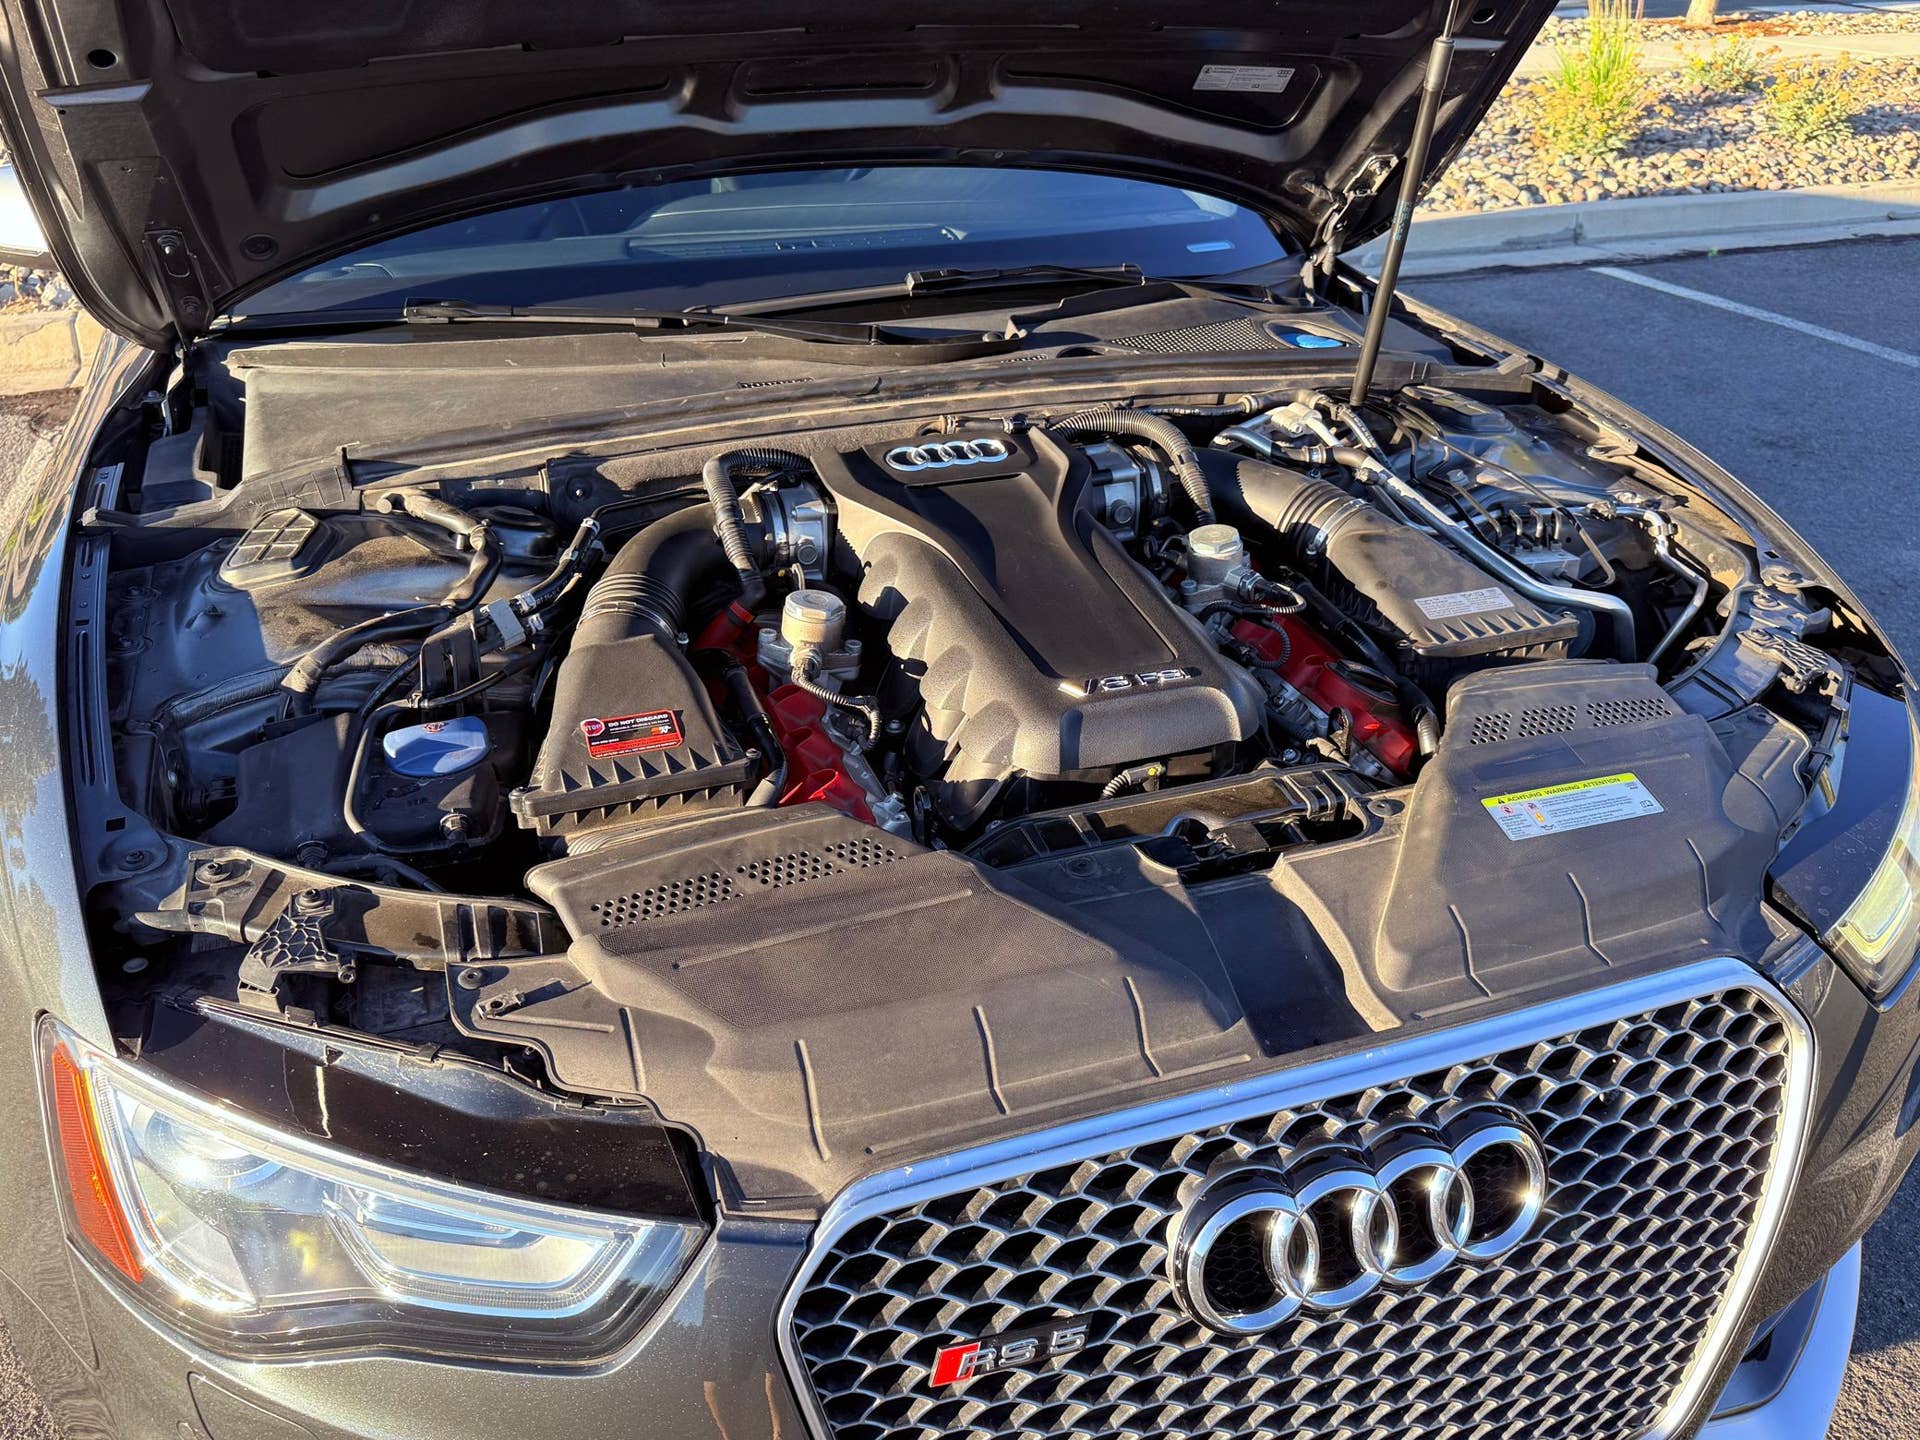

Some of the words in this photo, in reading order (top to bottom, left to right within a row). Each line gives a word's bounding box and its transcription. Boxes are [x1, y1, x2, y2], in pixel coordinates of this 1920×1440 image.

[636, 714, 668, 723] DISCARD
[1507, 791, 1542, 802] ACHTUNG
[1545, 785, 1580, 795] WARNING
[1583, 777, 1621, 788] ATTENTION
[957, 1338, 1039, 1378] RS
[1049, 1325, 1088, 1355] 5
